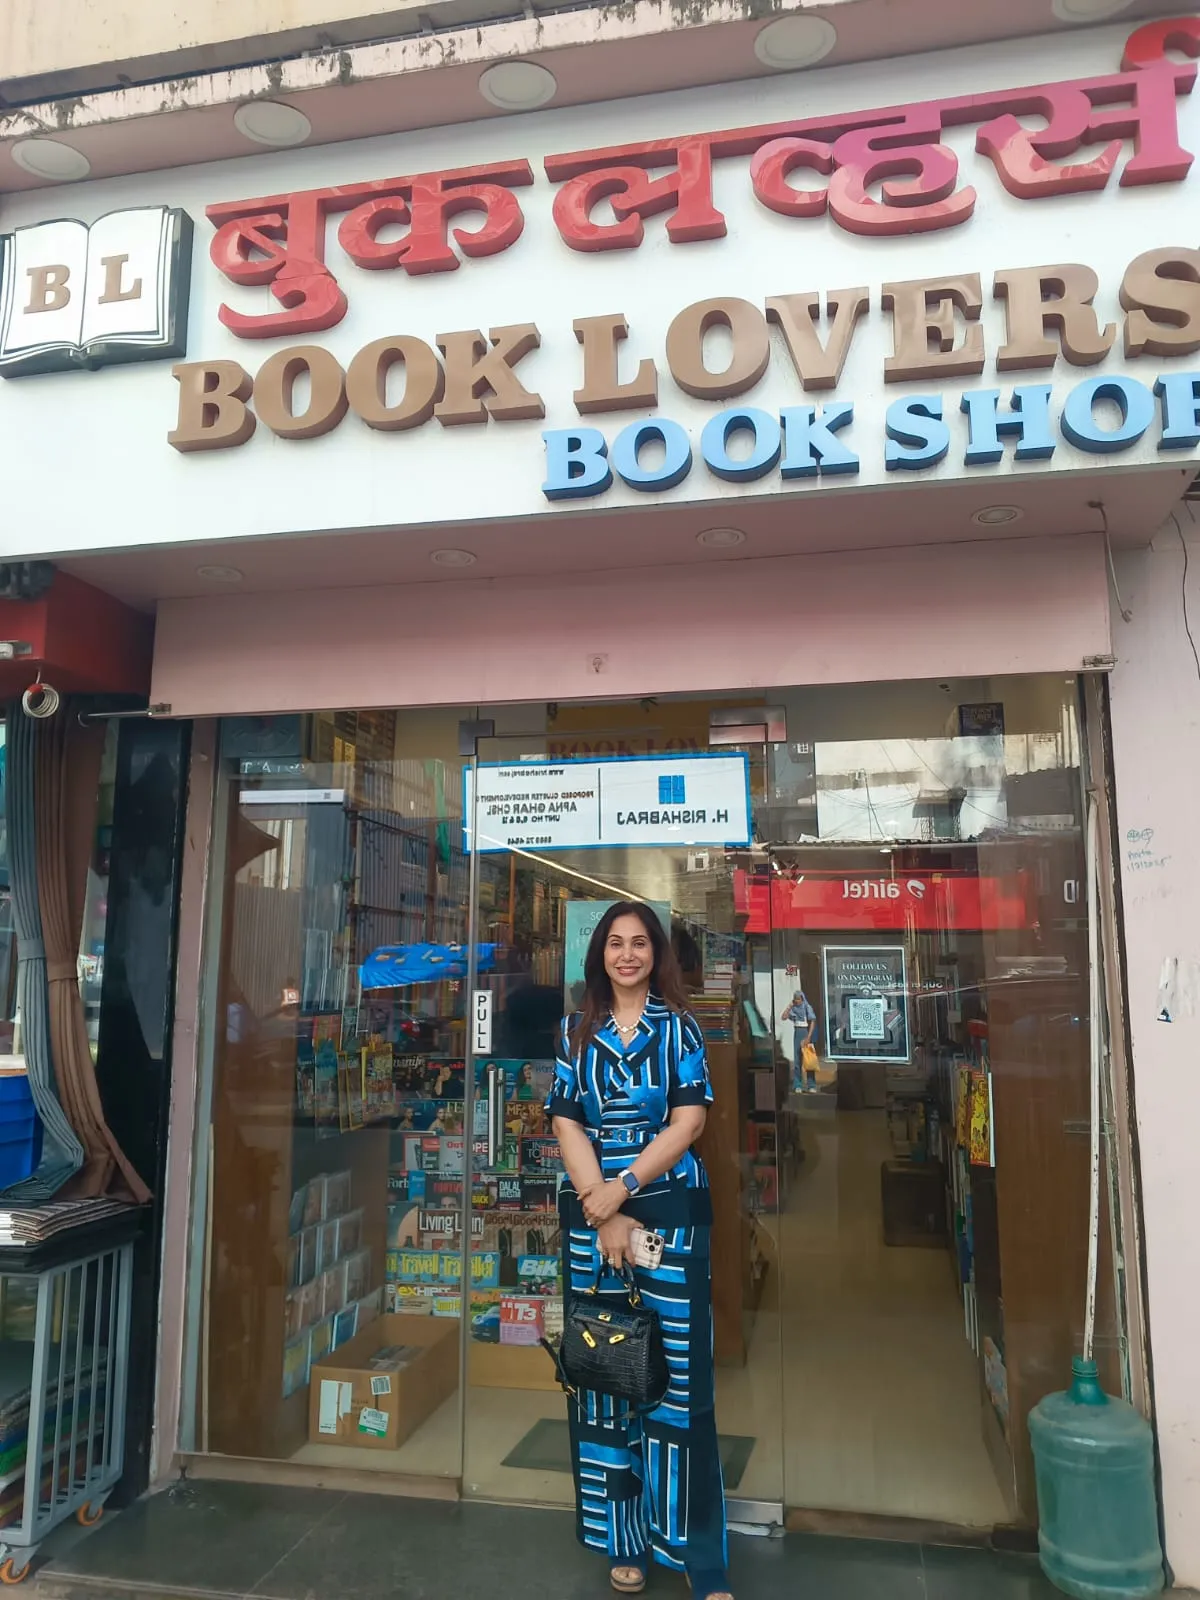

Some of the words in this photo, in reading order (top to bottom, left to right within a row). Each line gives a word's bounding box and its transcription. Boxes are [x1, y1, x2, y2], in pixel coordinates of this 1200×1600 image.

[206, 158, 534, 339] बुक
[23, 264, 71, 315] B
[98, 253, 142, 304] L
[167, 322, 546, 453] BOOK
[573, 246, 1200, 413] LOVERS
[541, 401, 860, 501] BOOK
[477, 995, 487, 1049] PULL
[388, 1178, 408, 1189] Forb
[420, 1211, 454, 1233] Living
[520, 1259, 558, 1276] BiK
[514, 1303, 537, 1321] T3
